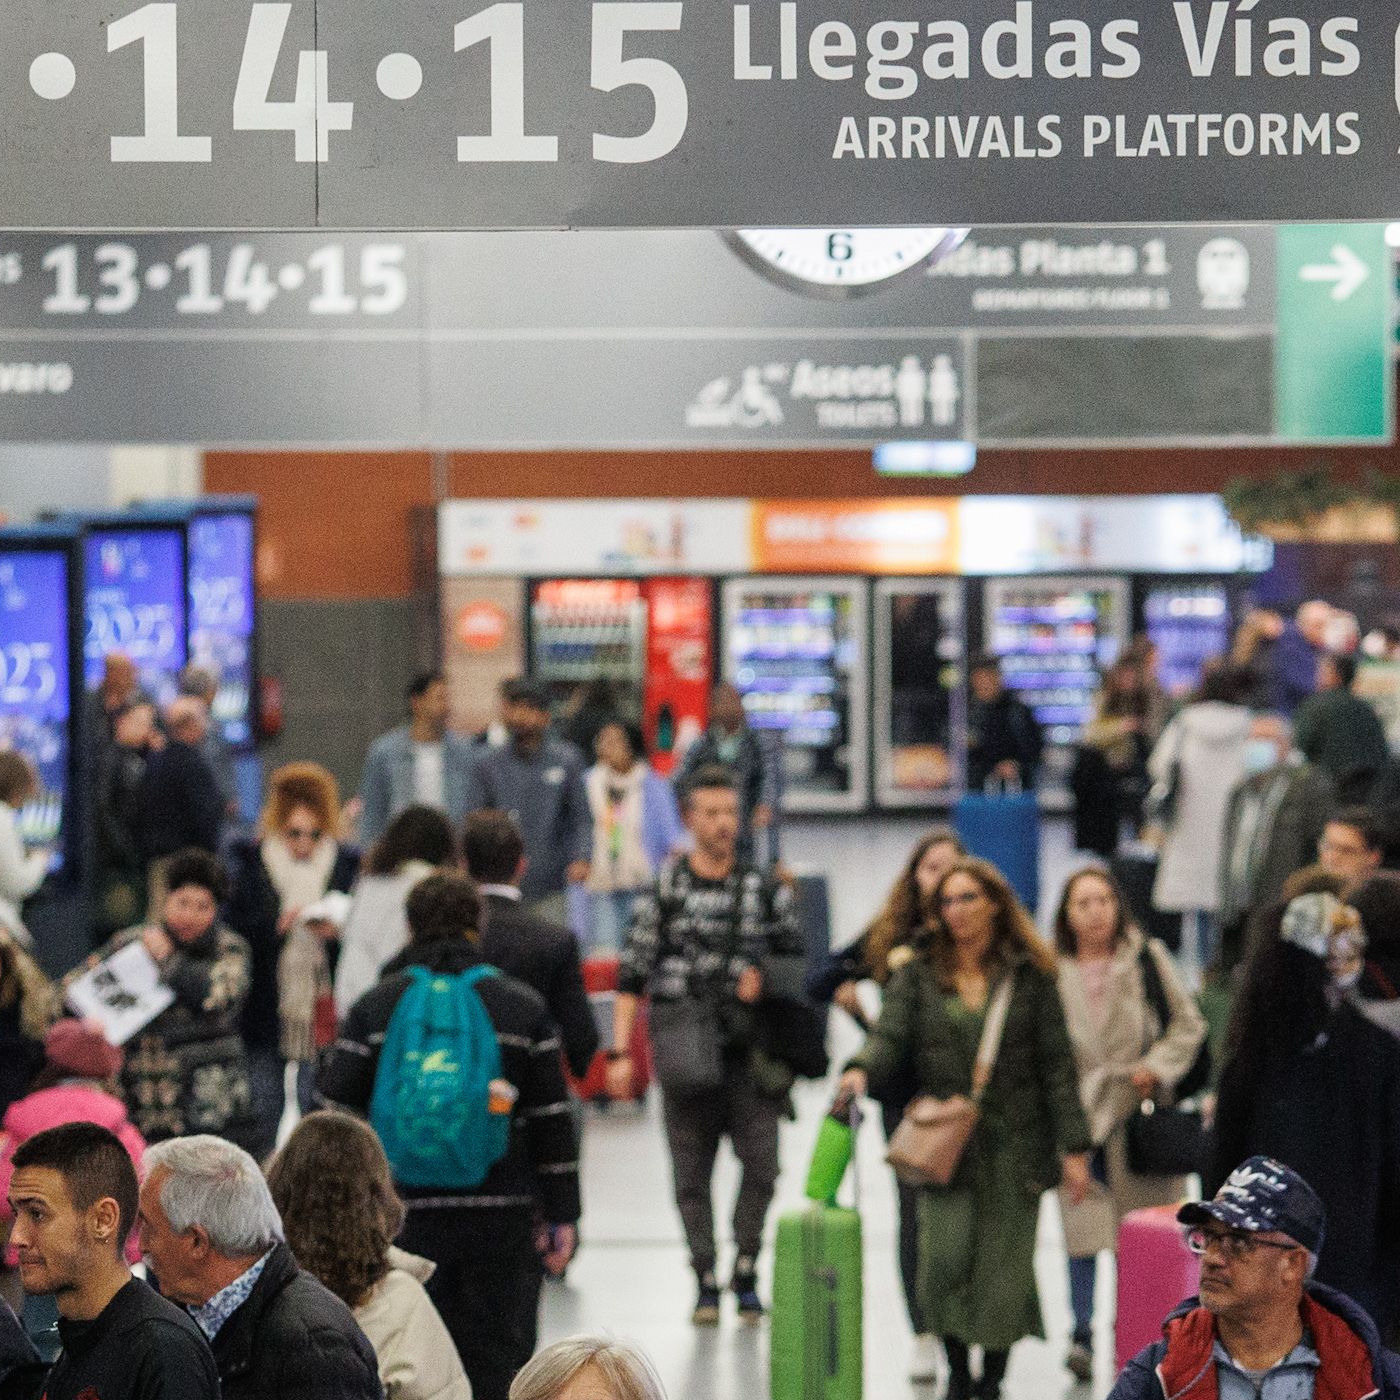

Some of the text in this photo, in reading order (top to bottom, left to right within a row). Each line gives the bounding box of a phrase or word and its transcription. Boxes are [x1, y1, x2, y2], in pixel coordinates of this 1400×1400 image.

[733, 0, 1360, 100] Llegadas Vías
[833, 112, 1360, 159] ARRIVALS PLATFORMS
[827, 231, 854, 261] 6
[1142, 237, 1172, 276] 1
[791, 357, 894, 399] Aseos
